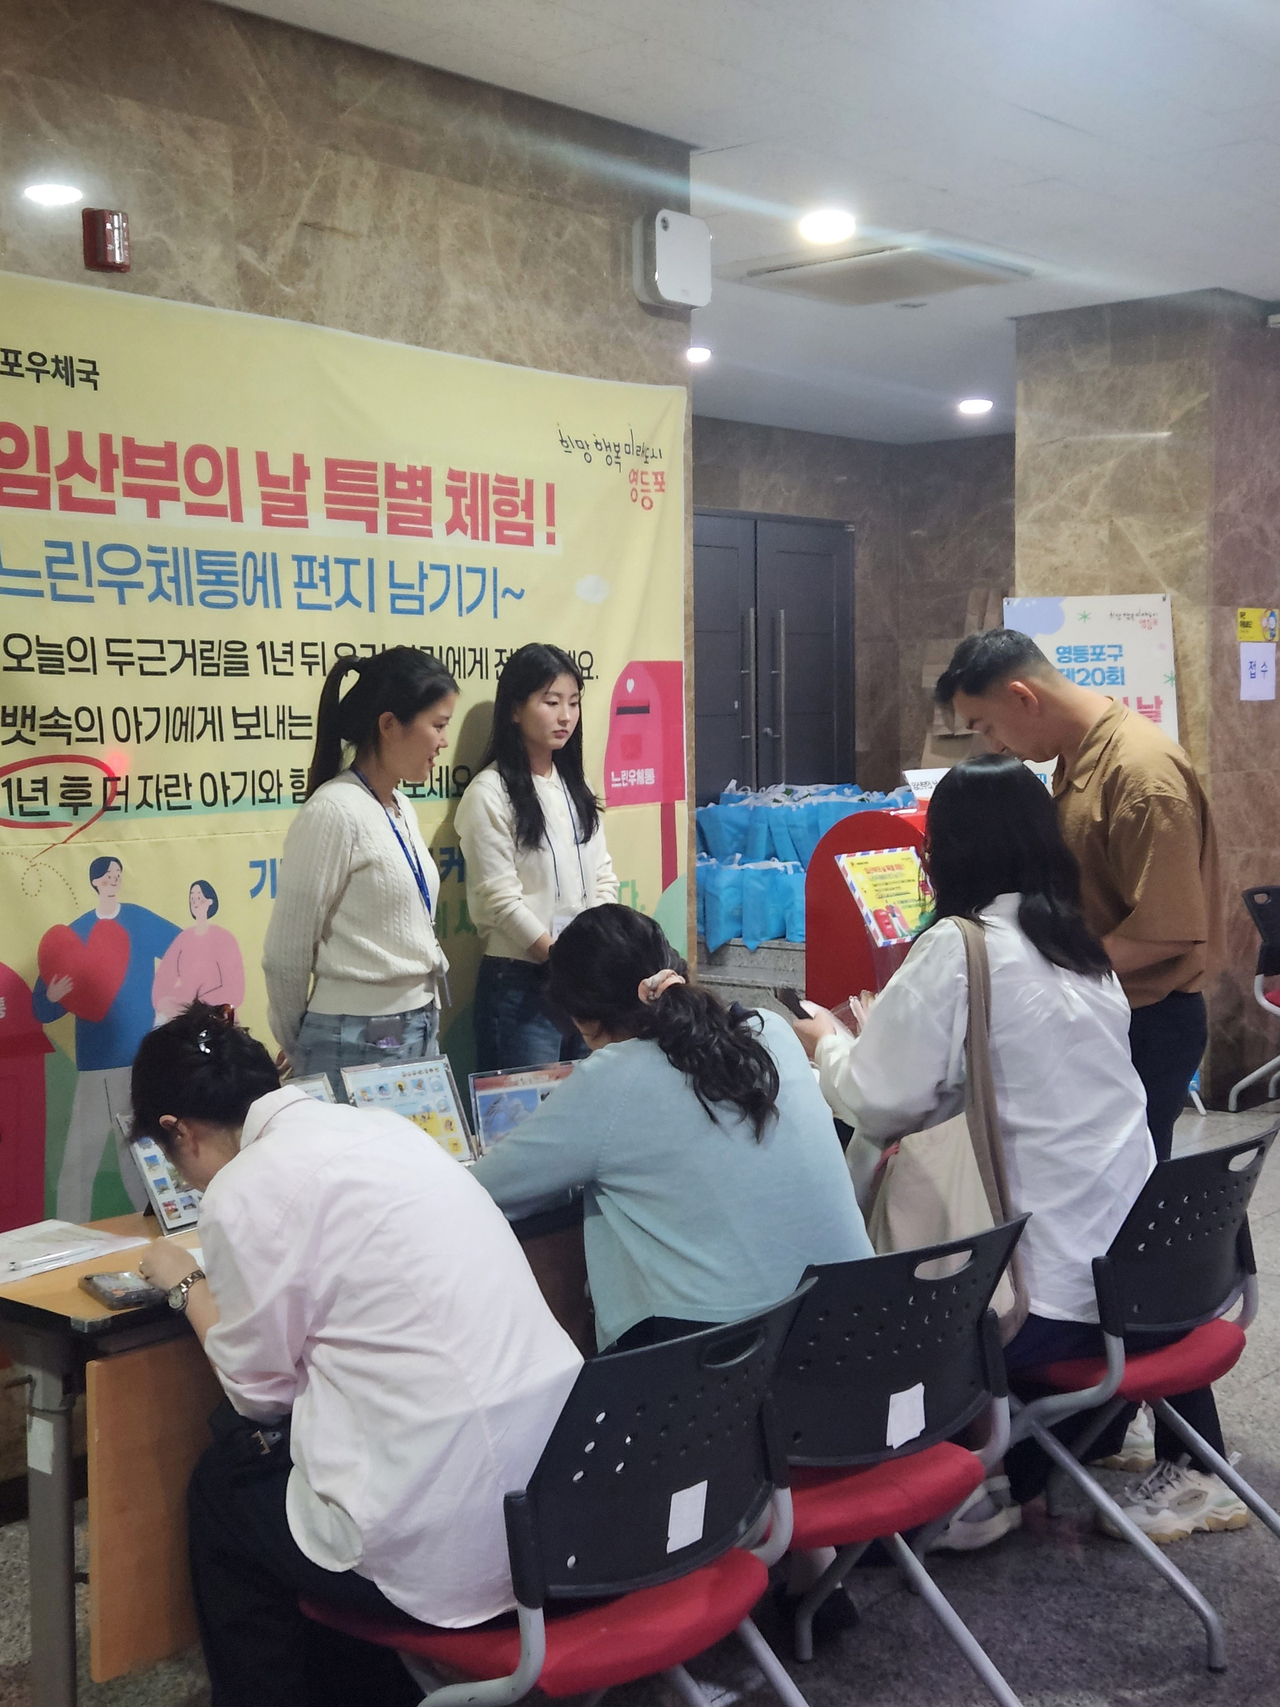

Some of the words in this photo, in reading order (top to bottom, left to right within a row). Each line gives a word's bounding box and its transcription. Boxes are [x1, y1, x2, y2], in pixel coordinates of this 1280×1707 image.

[0, 348, 100, 391] 포우체국
[0, 421, 244, 523] 임산부의
[255, 451, 311, 529] 날
[324, 457, 433, 539] 특별
[445, 467, 556, 547] 체험!
[628, 468, 666, 511] 영등포
[0, 539, 282, 609] 느린우체통에
[291, 554, 376, 613] 편지
[388, 559, 525, 619] 남기기~
[2, 632, 98, 676] 오늘의
[105, 637, 250, 677] 두근거림을
[256, 640, 294, 676] 1년
[300, 640, 327, 677] 뒤
[1055, 643, 1124, 664] 영등포구
[0, 704, 105, 746] 뱃속의
[112, 704, 225, 745] 아기에게
[232, 703, 314, 741] 보내는
[0, 775, 51, 817] 1년
[59, 774, 94, 817] 후
[101, 774, 130, 813] 더
[136, 773, 193, 812] 자란
[199, 769, 283, 808] 아기와
